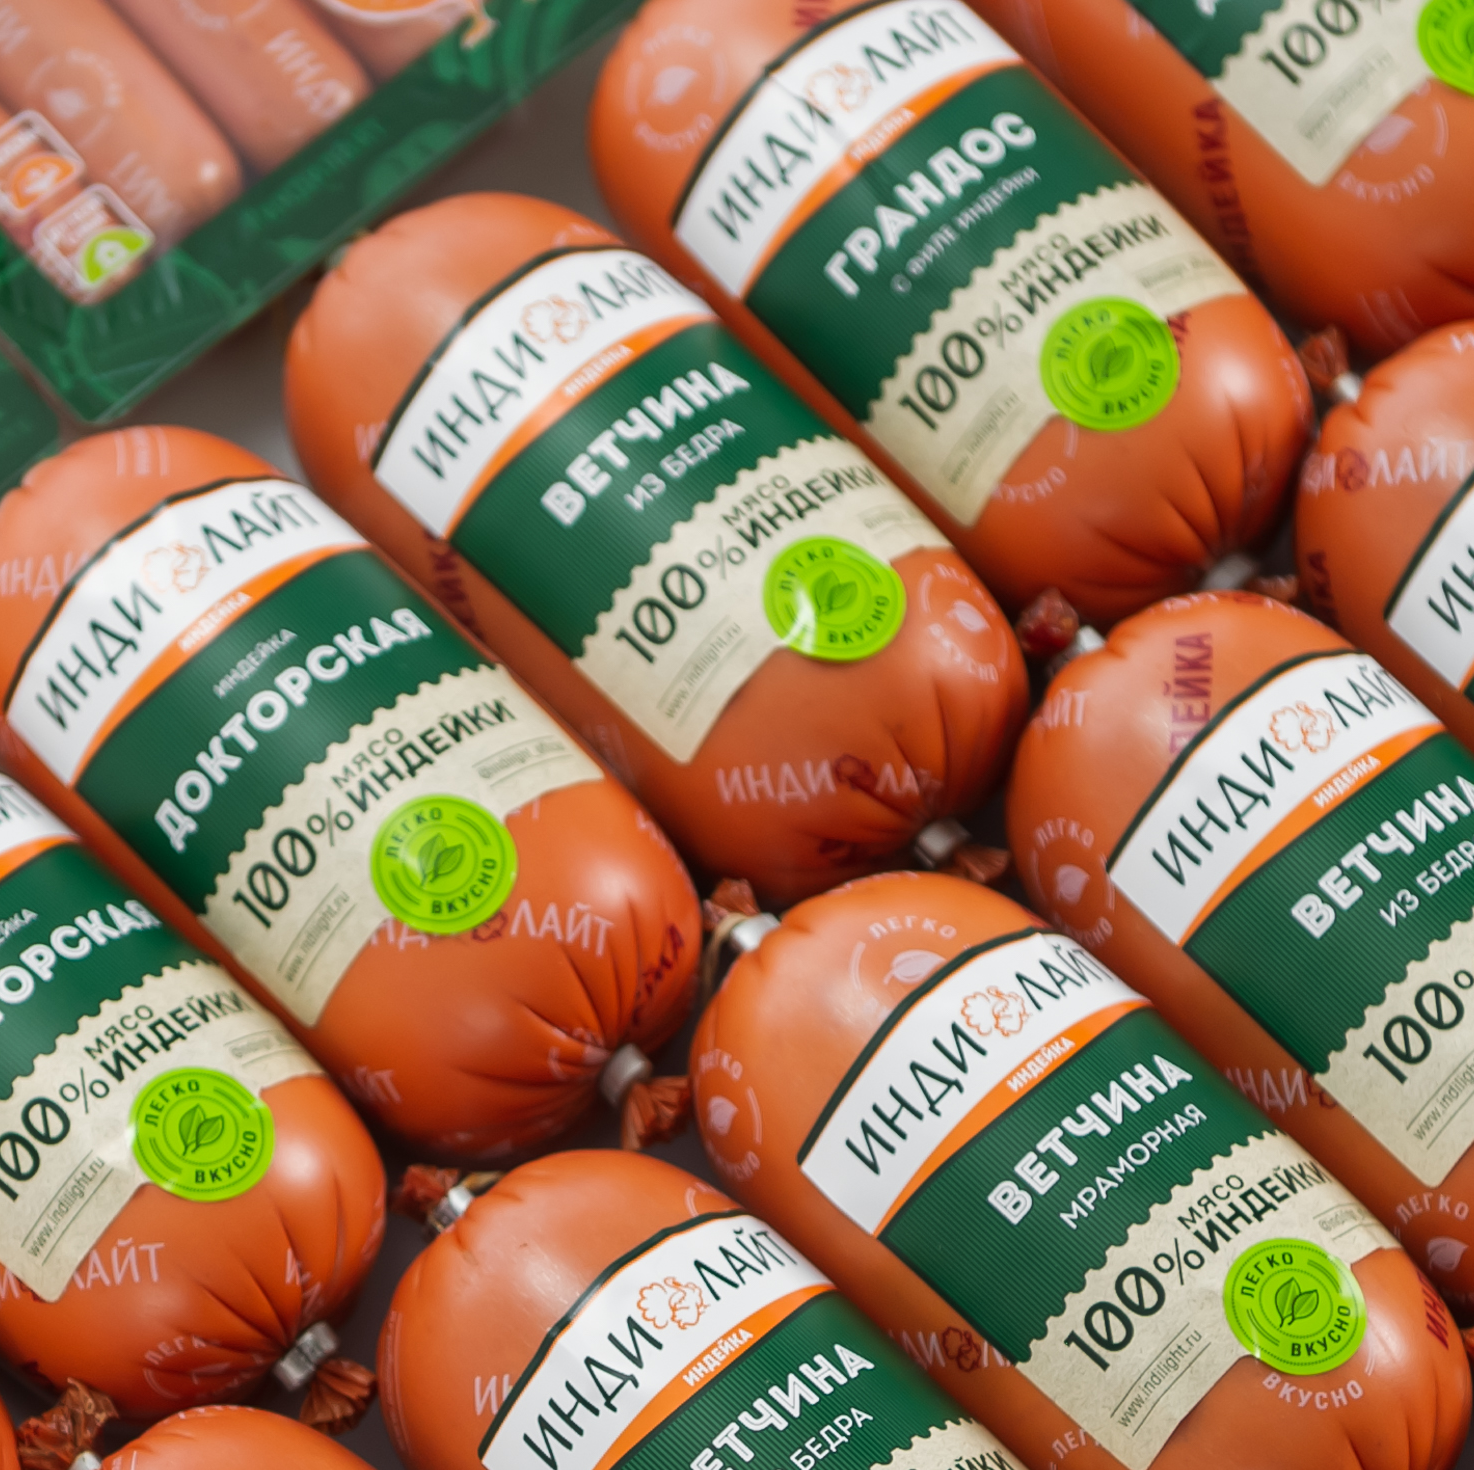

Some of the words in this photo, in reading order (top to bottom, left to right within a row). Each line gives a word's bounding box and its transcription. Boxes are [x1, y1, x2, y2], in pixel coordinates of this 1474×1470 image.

[826, 112, 1037, 298] ГРАНДОС
[1017, 214, 1172, 322] ИНДЕЙКИ
[899, 305, 1022, 432] 100%
[541, 362, 751, 527] ВЕТЧИНА
[625, 474, 668, 512] ИЗ
[662, 418, 746, 481] БЕДРА
[213, 627, 297, 700] ИНДЕЙКА
[154, 609, 432, 851] ДОКТОРСКАЯ
[352, 697, 516, 813] ИНДЕЙКИ
[232, 798, 355, 929] 100%
[1381, 889, 1419, 927] ИЗ
[988, 1053, 1193, 1225] ВЕТЧИНА
[1059, 1103, 1207, 1231] МРАМОРНАЯ
[1197, 1161, 1330, 1254] ИНДЕЙКИ
[1063, 1237, 1204, 1372] 100%
[1290, 1302, 1351, 1356] ВКУСНО
[1262, 1372, 1365, 1411] ВКУСНО
